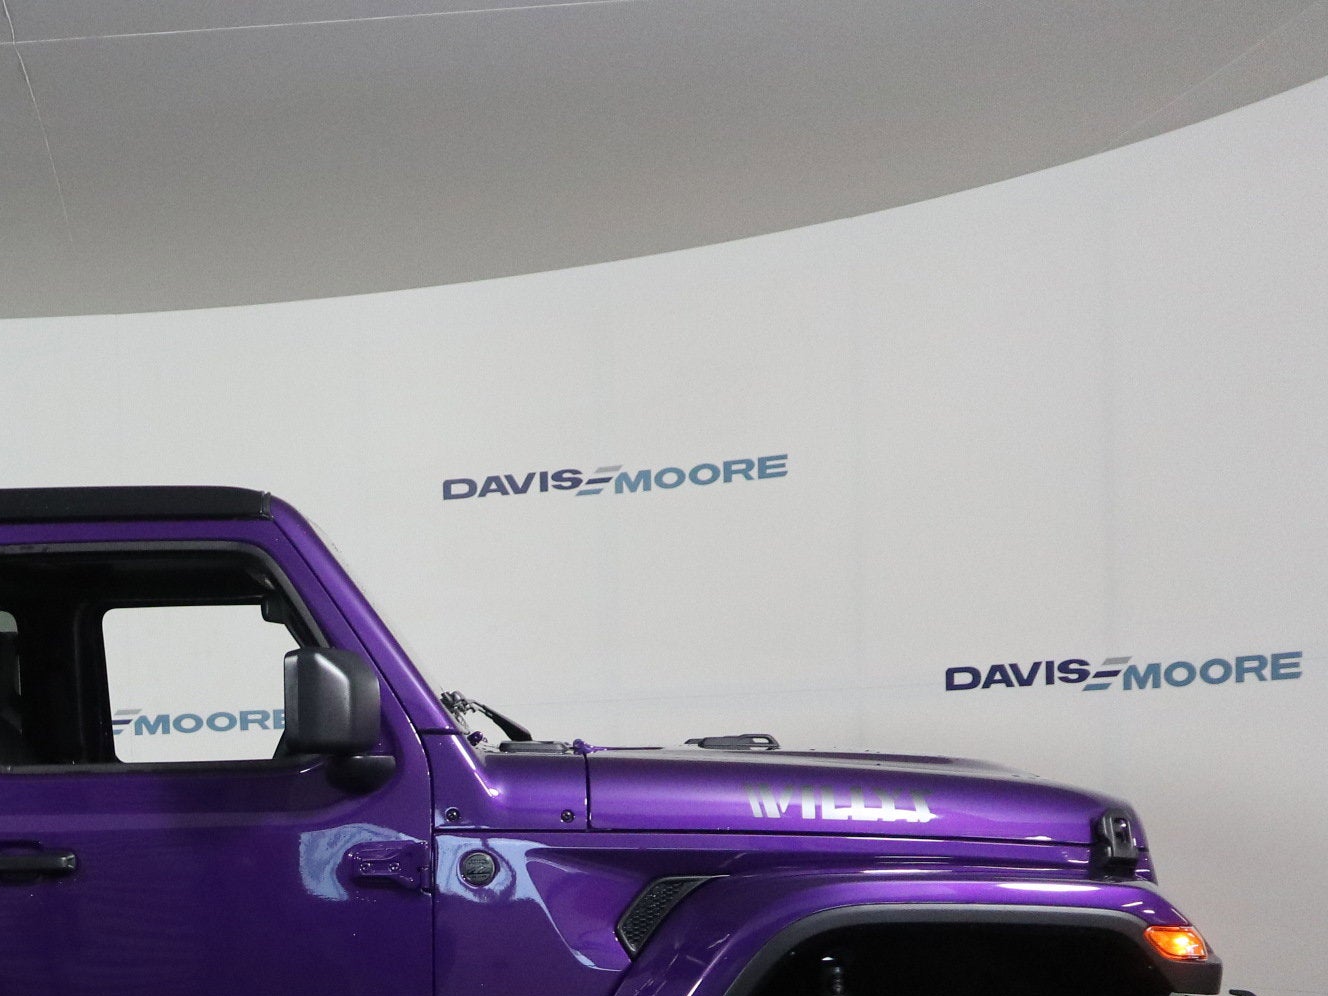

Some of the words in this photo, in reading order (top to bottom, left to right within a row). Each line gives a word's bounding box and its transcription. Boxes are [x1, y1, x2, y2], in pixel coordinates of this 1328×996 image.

[442, 468, 583, 500] DAVIS
[614, 453, 789, 494] MOORE
[945, 658, 1091, 691] DAVIS
[1122, 650, 1303, 691] MOORE
[745, 783, 938, 824] WILLYS
